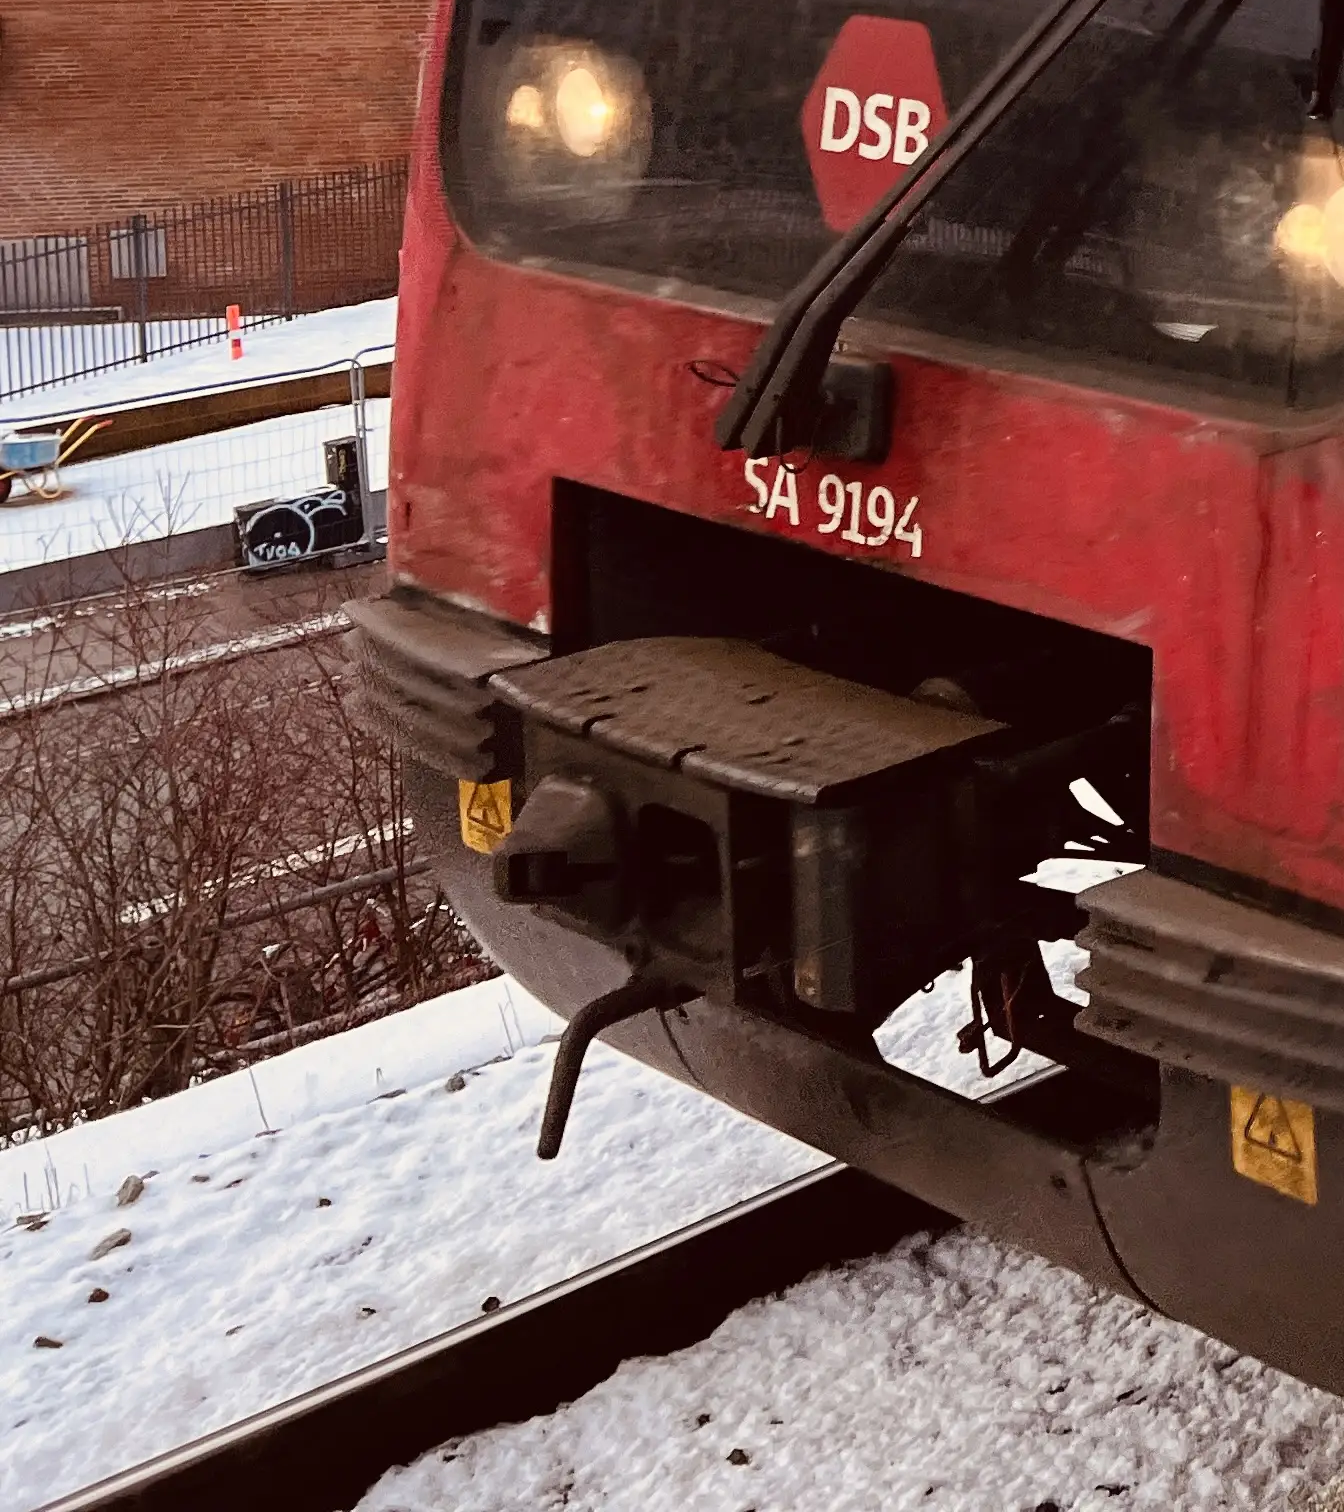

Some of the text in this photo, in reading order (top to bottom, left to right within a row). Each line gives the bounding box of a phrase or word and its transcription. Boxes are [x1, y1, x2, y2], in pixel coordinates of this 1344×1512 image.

[819, 86, 932, 166] DSB
[737, 456, 923, 558] SA 9194
